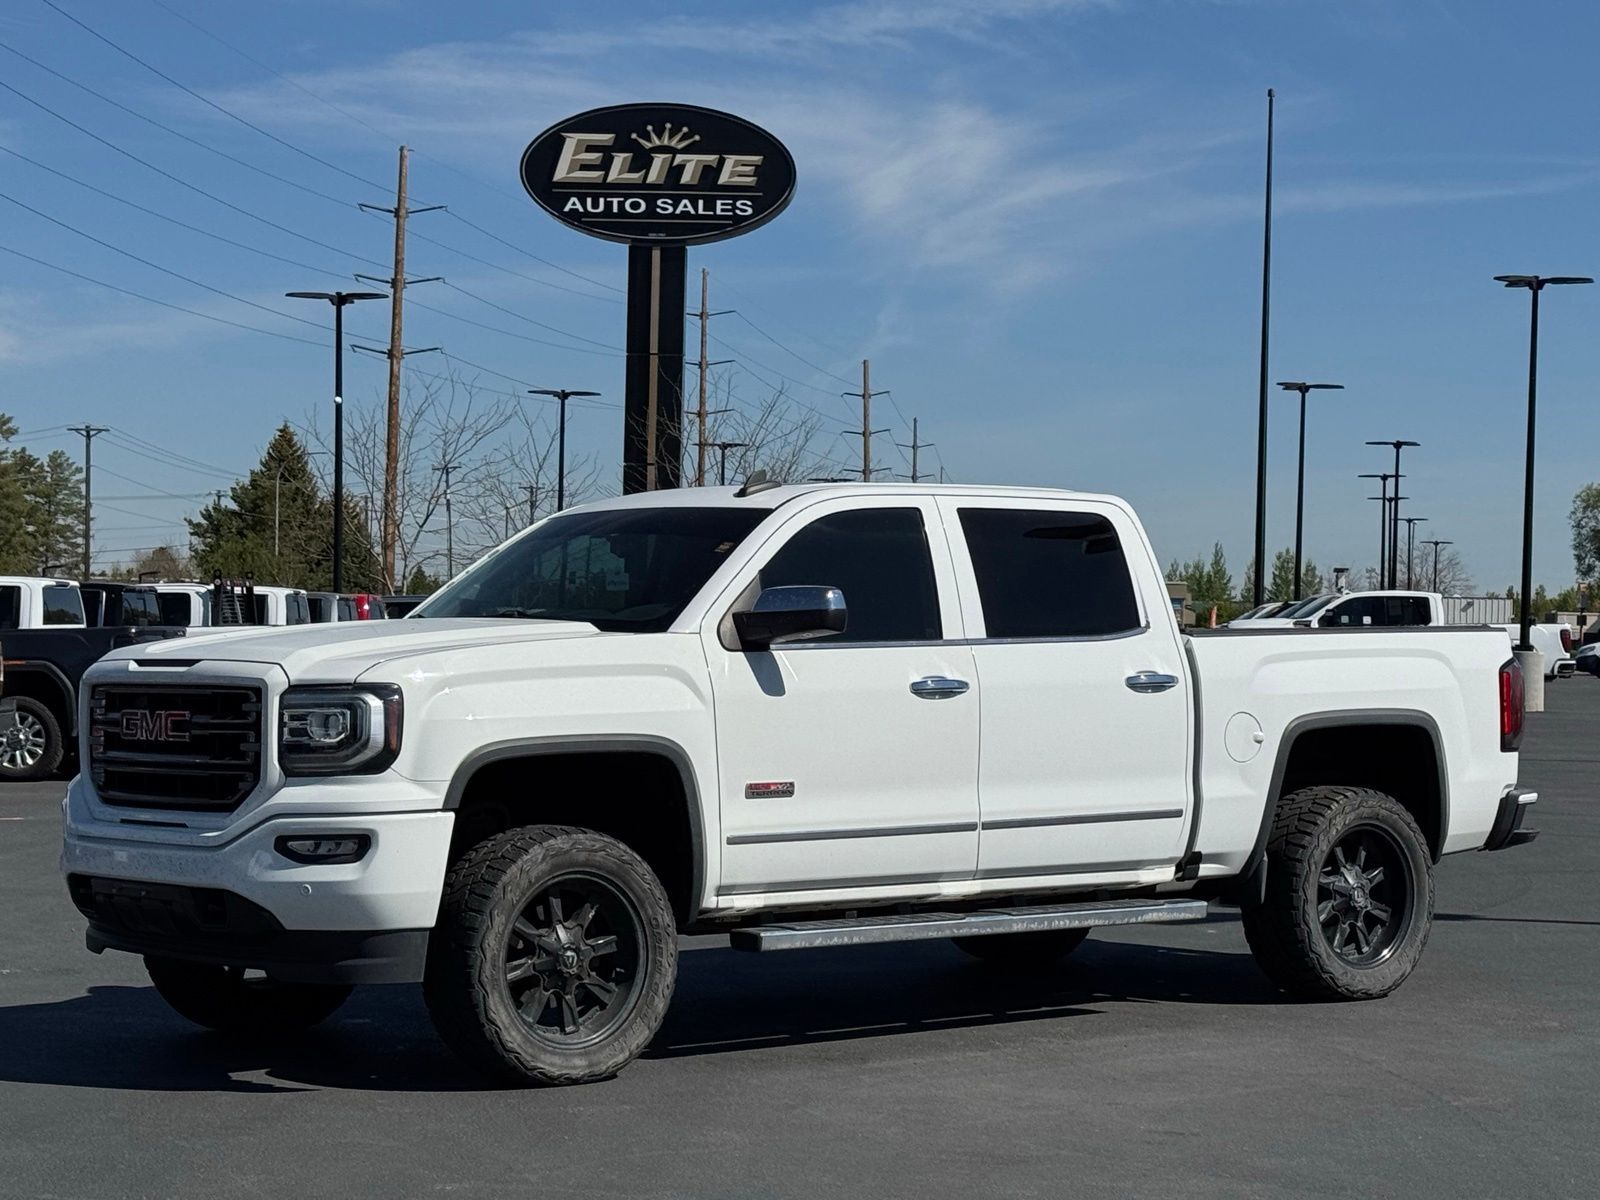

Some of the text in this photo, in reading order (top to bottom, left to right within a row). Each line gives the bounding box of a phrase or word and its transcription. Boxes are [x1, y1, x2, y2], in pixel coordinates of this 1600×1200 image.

[552, 132, 763, 186] ELITE
[563, 197, 754, 216] AUTO SALES
[120, 709, 191, 741] GMC
